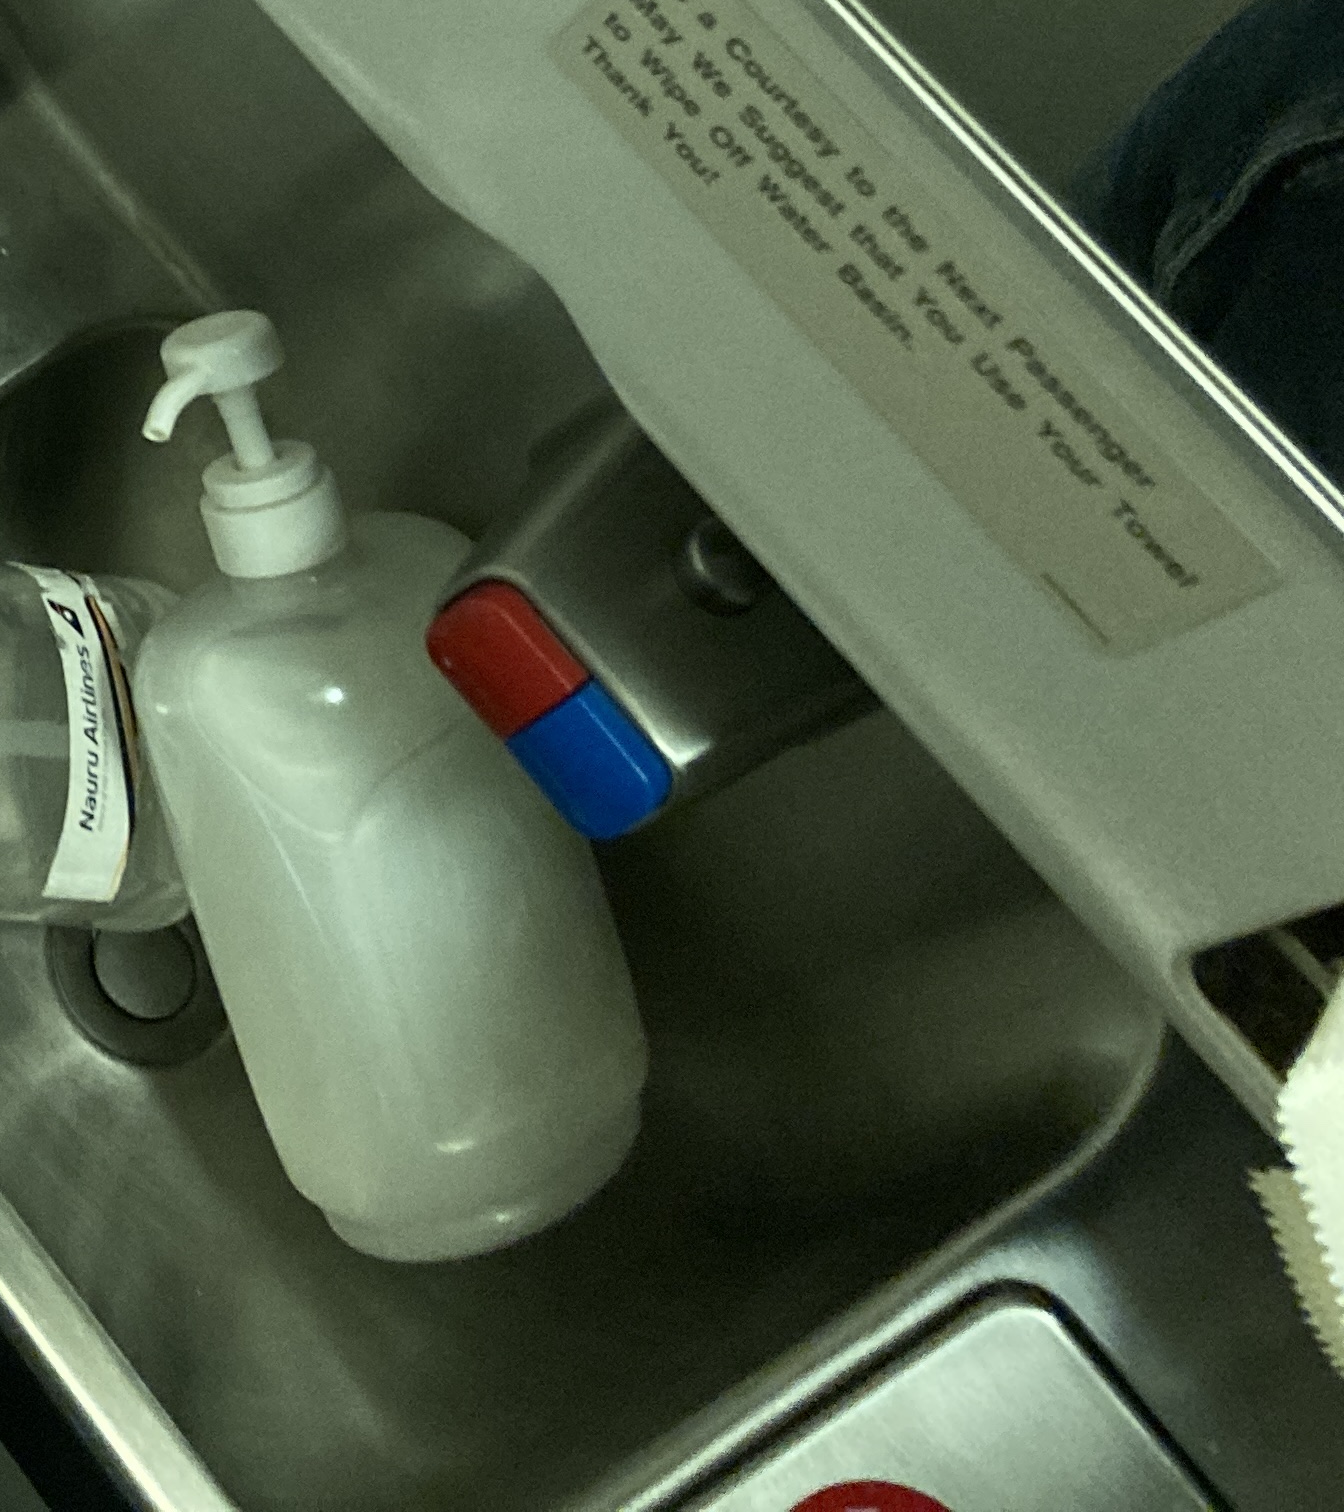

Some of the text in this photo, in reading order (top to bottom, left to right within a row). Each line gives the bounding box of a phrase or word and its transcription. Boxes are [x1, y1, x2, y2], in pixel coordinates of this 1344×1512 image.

[582, 35, 721, 185] Thank You!
[604, 12, 631, 42] to
[640, 48, 701, 117] Wipe
[709, 125, 755, 168] Off
[759, 173, 833, 254] Water
[693, 50, 732, 98] We
[738, 104, 845, 218] Suggest
[849, 224, 906, 281] that
[915, 287, 966, 345] You
[971, 351, 1028, 411] Use
[1038, 418, 1103, 487] Your
[1114, 497, 1200, 588] Towel
[697, 11, 717, 31] a
[725, 38, 841, 157] Courtesy
[845, 166, 877, 197] to
[882, 205, 929, 253] the
[936, 260, 1003, 329] Next
[1006, 337, 1155, 488] Passenger
[76, 644, 99, 831] Nauru Airlines
